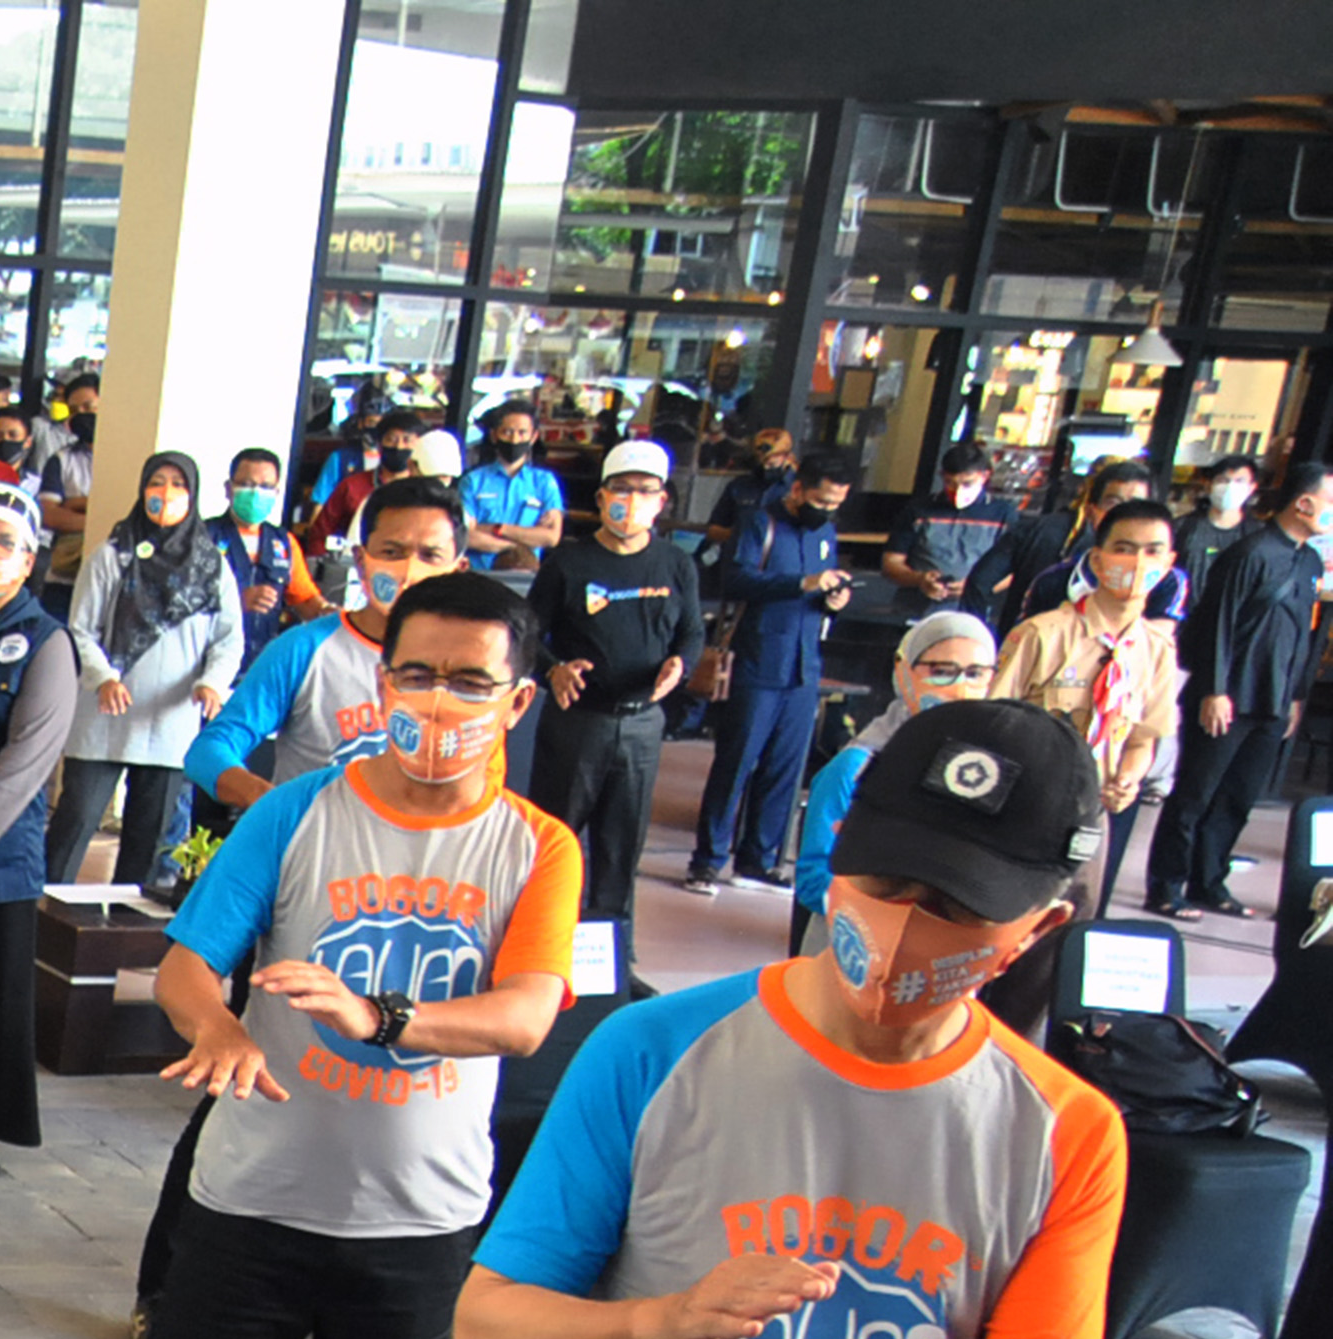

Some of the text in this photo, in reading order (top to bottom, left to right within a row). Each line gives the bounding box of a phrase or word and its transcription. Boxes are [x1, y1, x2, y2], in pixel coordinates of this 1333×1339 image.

[328, 872, 487, 928] BOGOR
[298, 1045, 461, 1107] COVID-19
[721, 1193, 965, 1297] BOGOR
